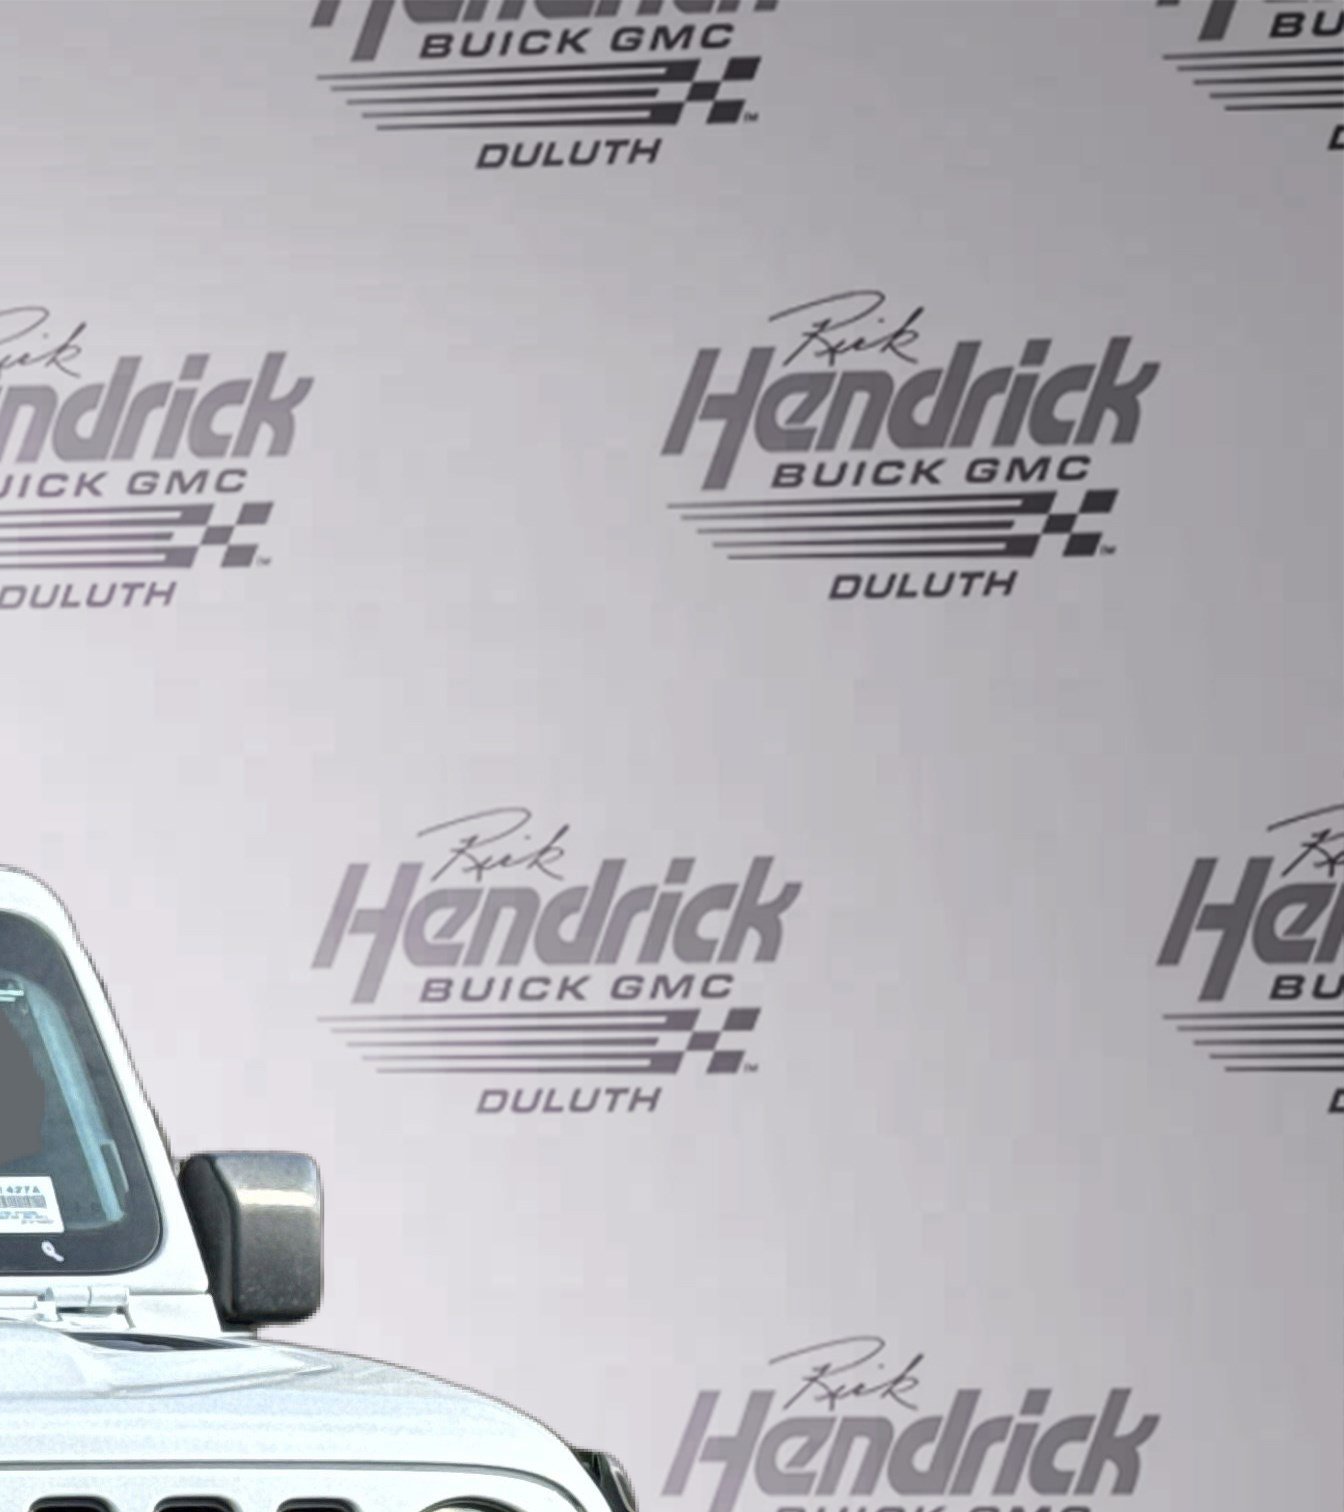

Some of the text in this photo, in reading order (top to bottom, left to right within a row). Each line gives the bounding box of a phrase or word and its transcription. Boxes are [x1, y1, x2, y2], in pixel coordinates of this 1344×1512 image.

[419, 28, 591, 59] BUICK
[610, 23, 734, 52] GMC
[476, 138, 662, 169] DULUTH
[661, 336, 1160, 490] Hendrick
[126, 468, 247, 495] GMC
[771, 455, 1091, 488] BUICK GMC
[829, 570, 1018, 600] DULUTH
[312, 856, 802, 1004] Hendrick
[420, 974, 734, 1003] BUICK GMC
[477, 1087, 662, 1114] DULUTH
